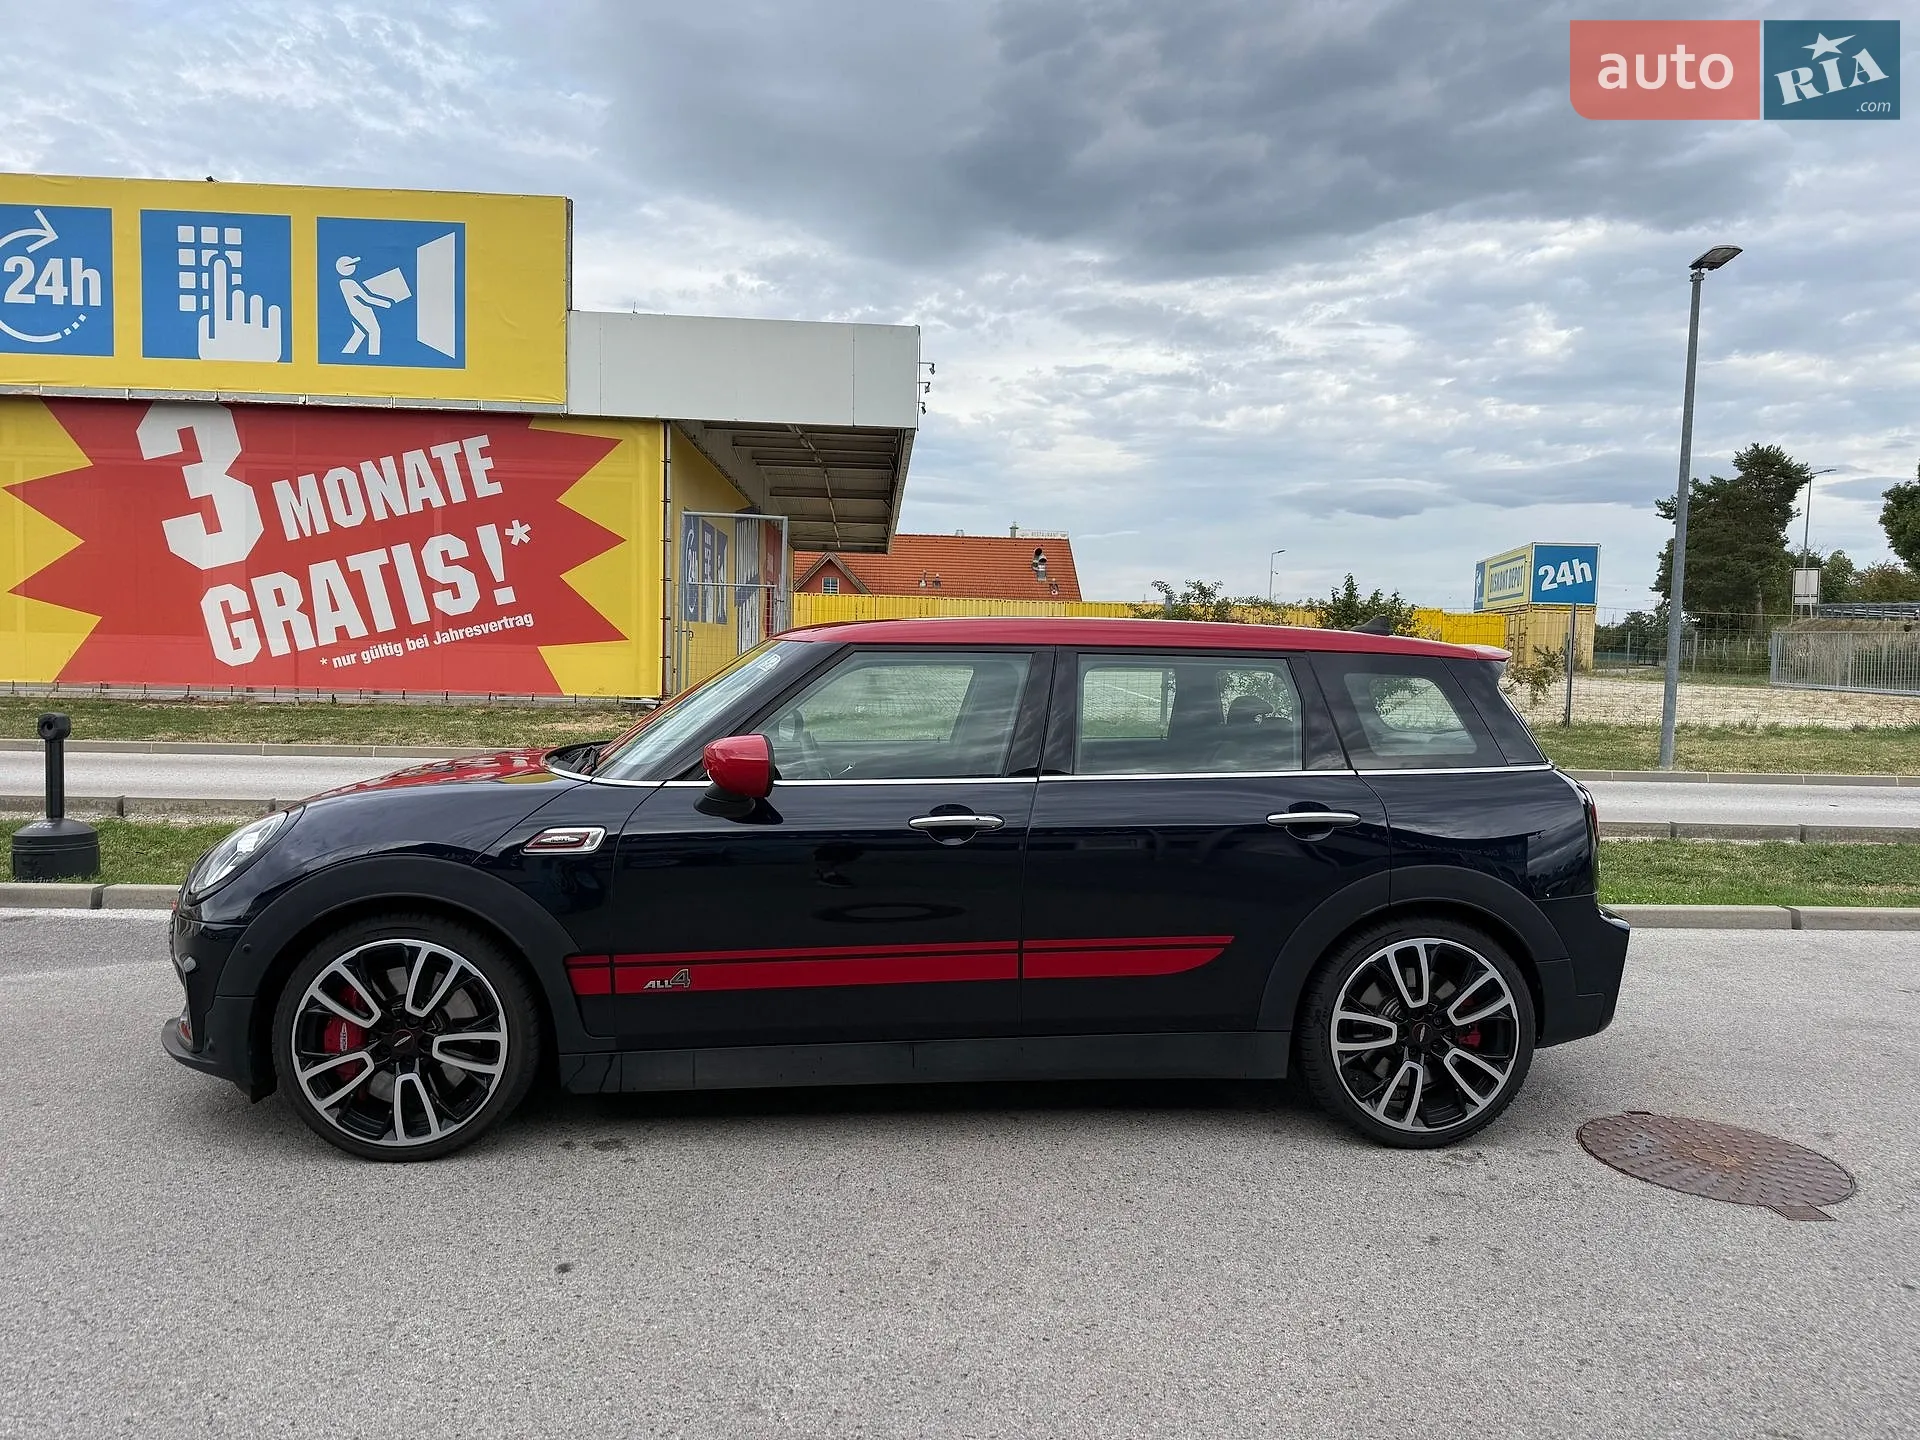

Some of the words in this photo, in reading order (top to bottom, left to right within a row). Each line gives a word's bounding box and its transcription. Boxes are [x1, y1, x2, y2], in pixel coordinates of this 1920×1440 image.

[3, 255, 102, 307] 24h
[135, 401, 265, 570] 3
[271, 434, 503, 542] MONATE
[1538, 558, 1593, 592] 24h
[332, 653, 358, 669] nur
[361, 641, 403, 665] gültig
[406, 633, 430, 652] bei
[433, 612, 534, 645] Jahresvertrag
[643, 968, 691, 989] ALL4
